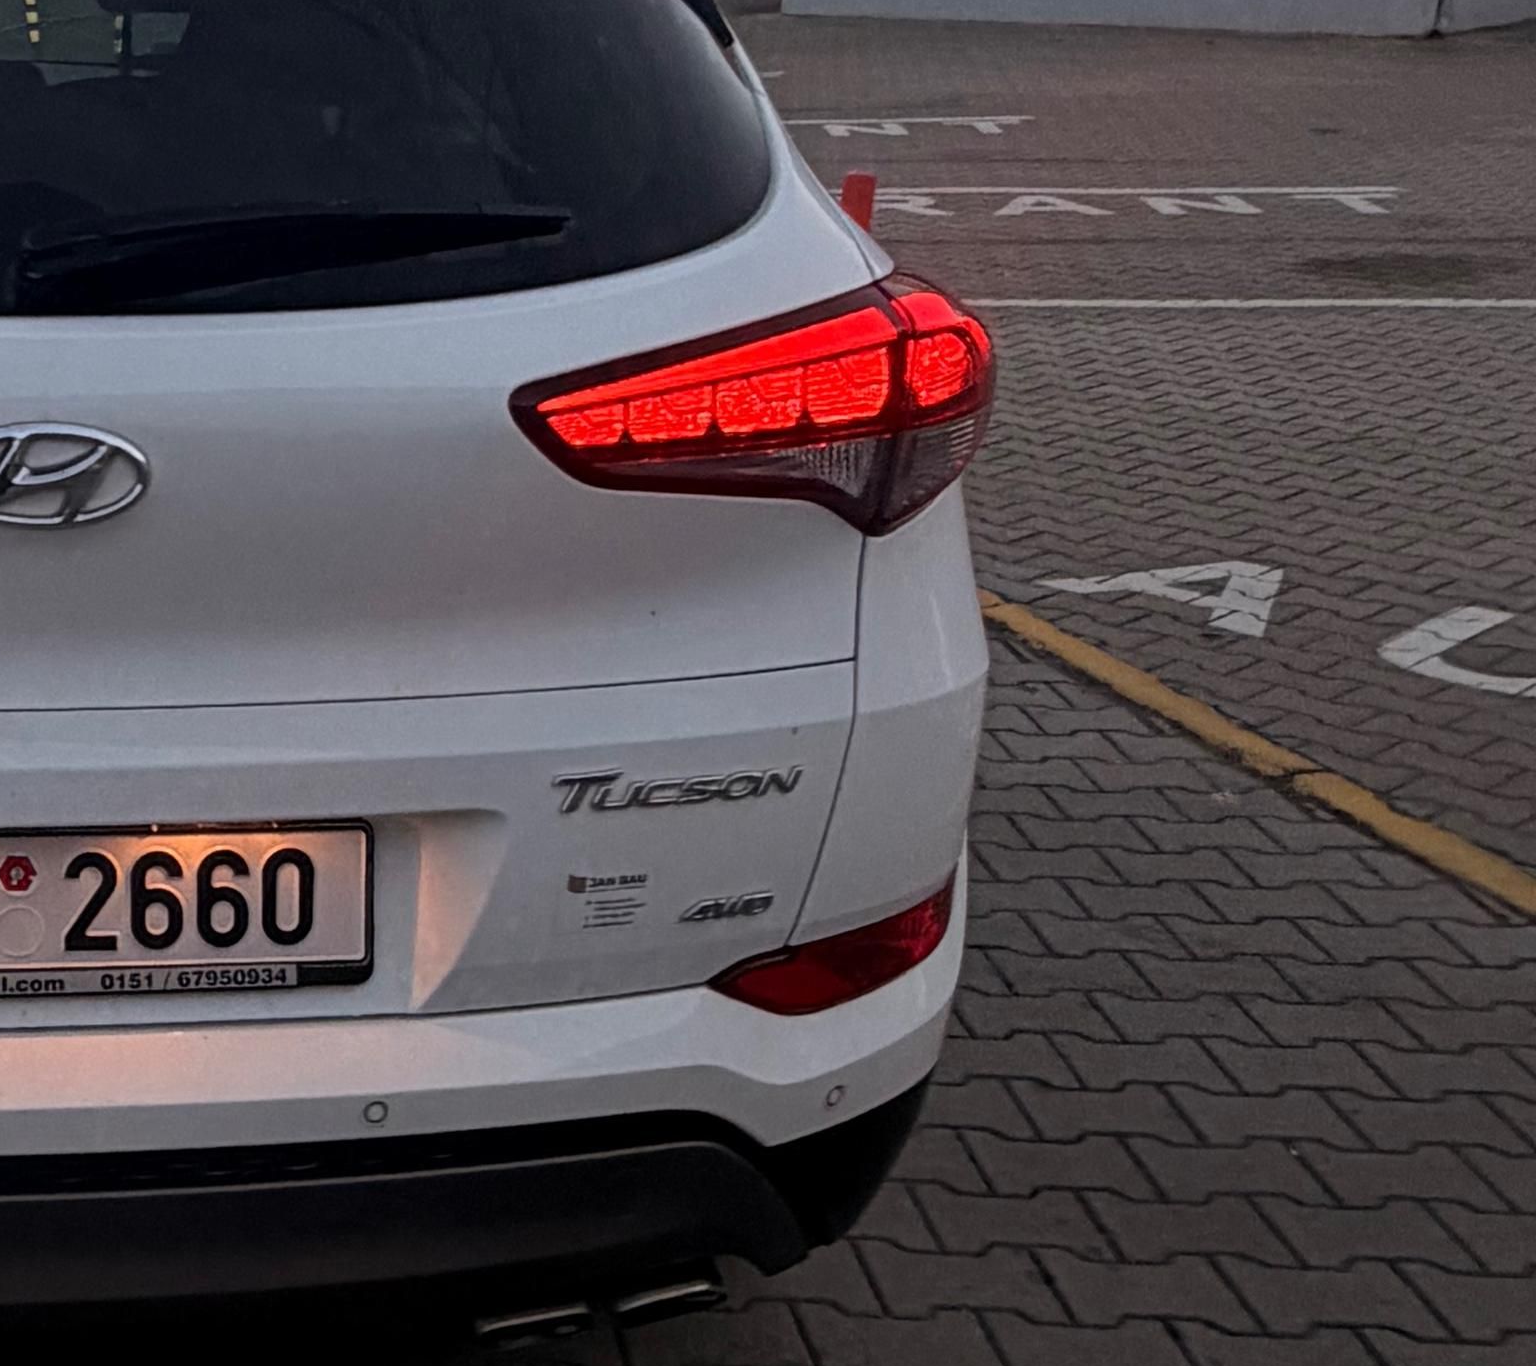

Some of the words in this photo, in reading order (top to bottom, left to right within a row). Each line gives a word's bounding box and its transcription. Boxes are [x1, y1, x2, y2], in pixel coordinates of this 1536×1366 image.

[64, 848, 315, 952] 2660
[100, 972, 154, 990] 0151
[177, 967, 287, 988] 67950934
